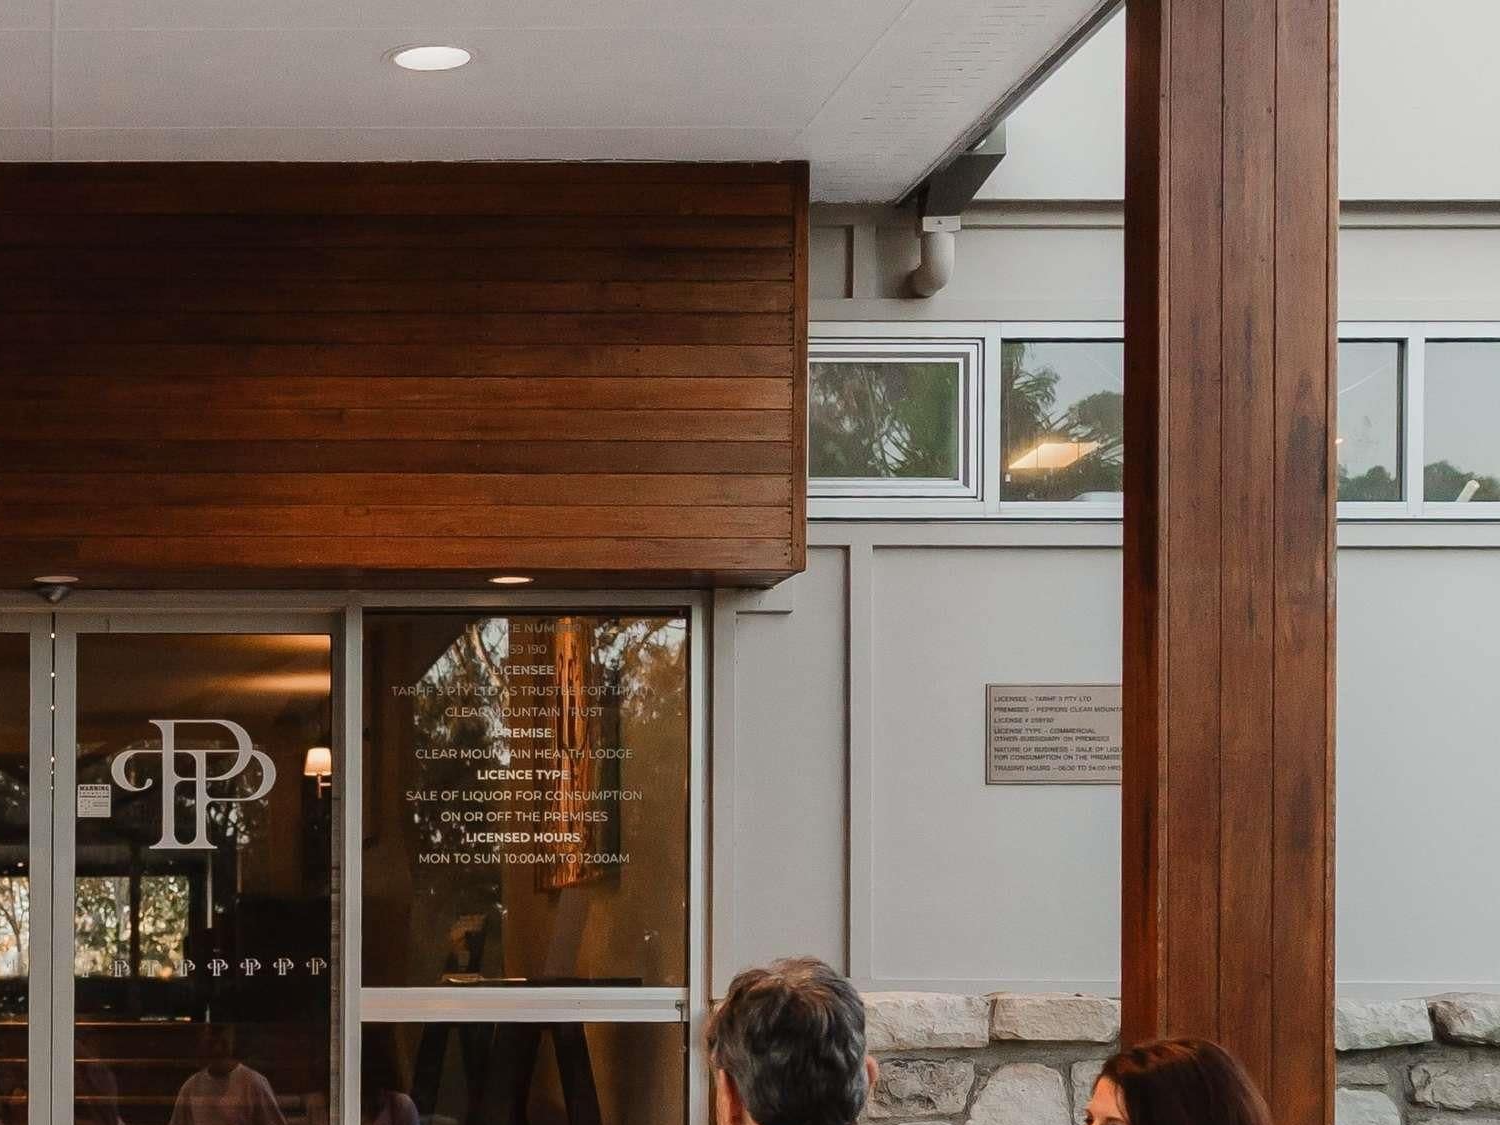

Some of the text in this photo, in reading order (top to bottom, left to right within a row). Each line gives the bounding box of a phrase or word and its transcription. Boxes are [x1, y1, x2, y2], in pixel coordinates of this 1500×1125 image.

[447, 685, 470, 696] PTY
[474, 686, 498, 696] LTD
[500, 686, 518, 696] AS
[581, 686, 607, 696] FOR
[565, 707, 604, 717] RUST
[415, 749, 634, 759] CLEAR MOUNAIN HEALTH LODGE
[477, 769, 533, 780] LICENCE
[406, 790, 644, 803] SALE OF LIQUOR FOR CONSUMPTION
[440, 811, 609, 822] ON OR OFF THE PREMISES
[466, 832, 530, 843] LICENSED
[419, 853, 630, 864] MON TO SUN 10:00AM TO 12:00AM
